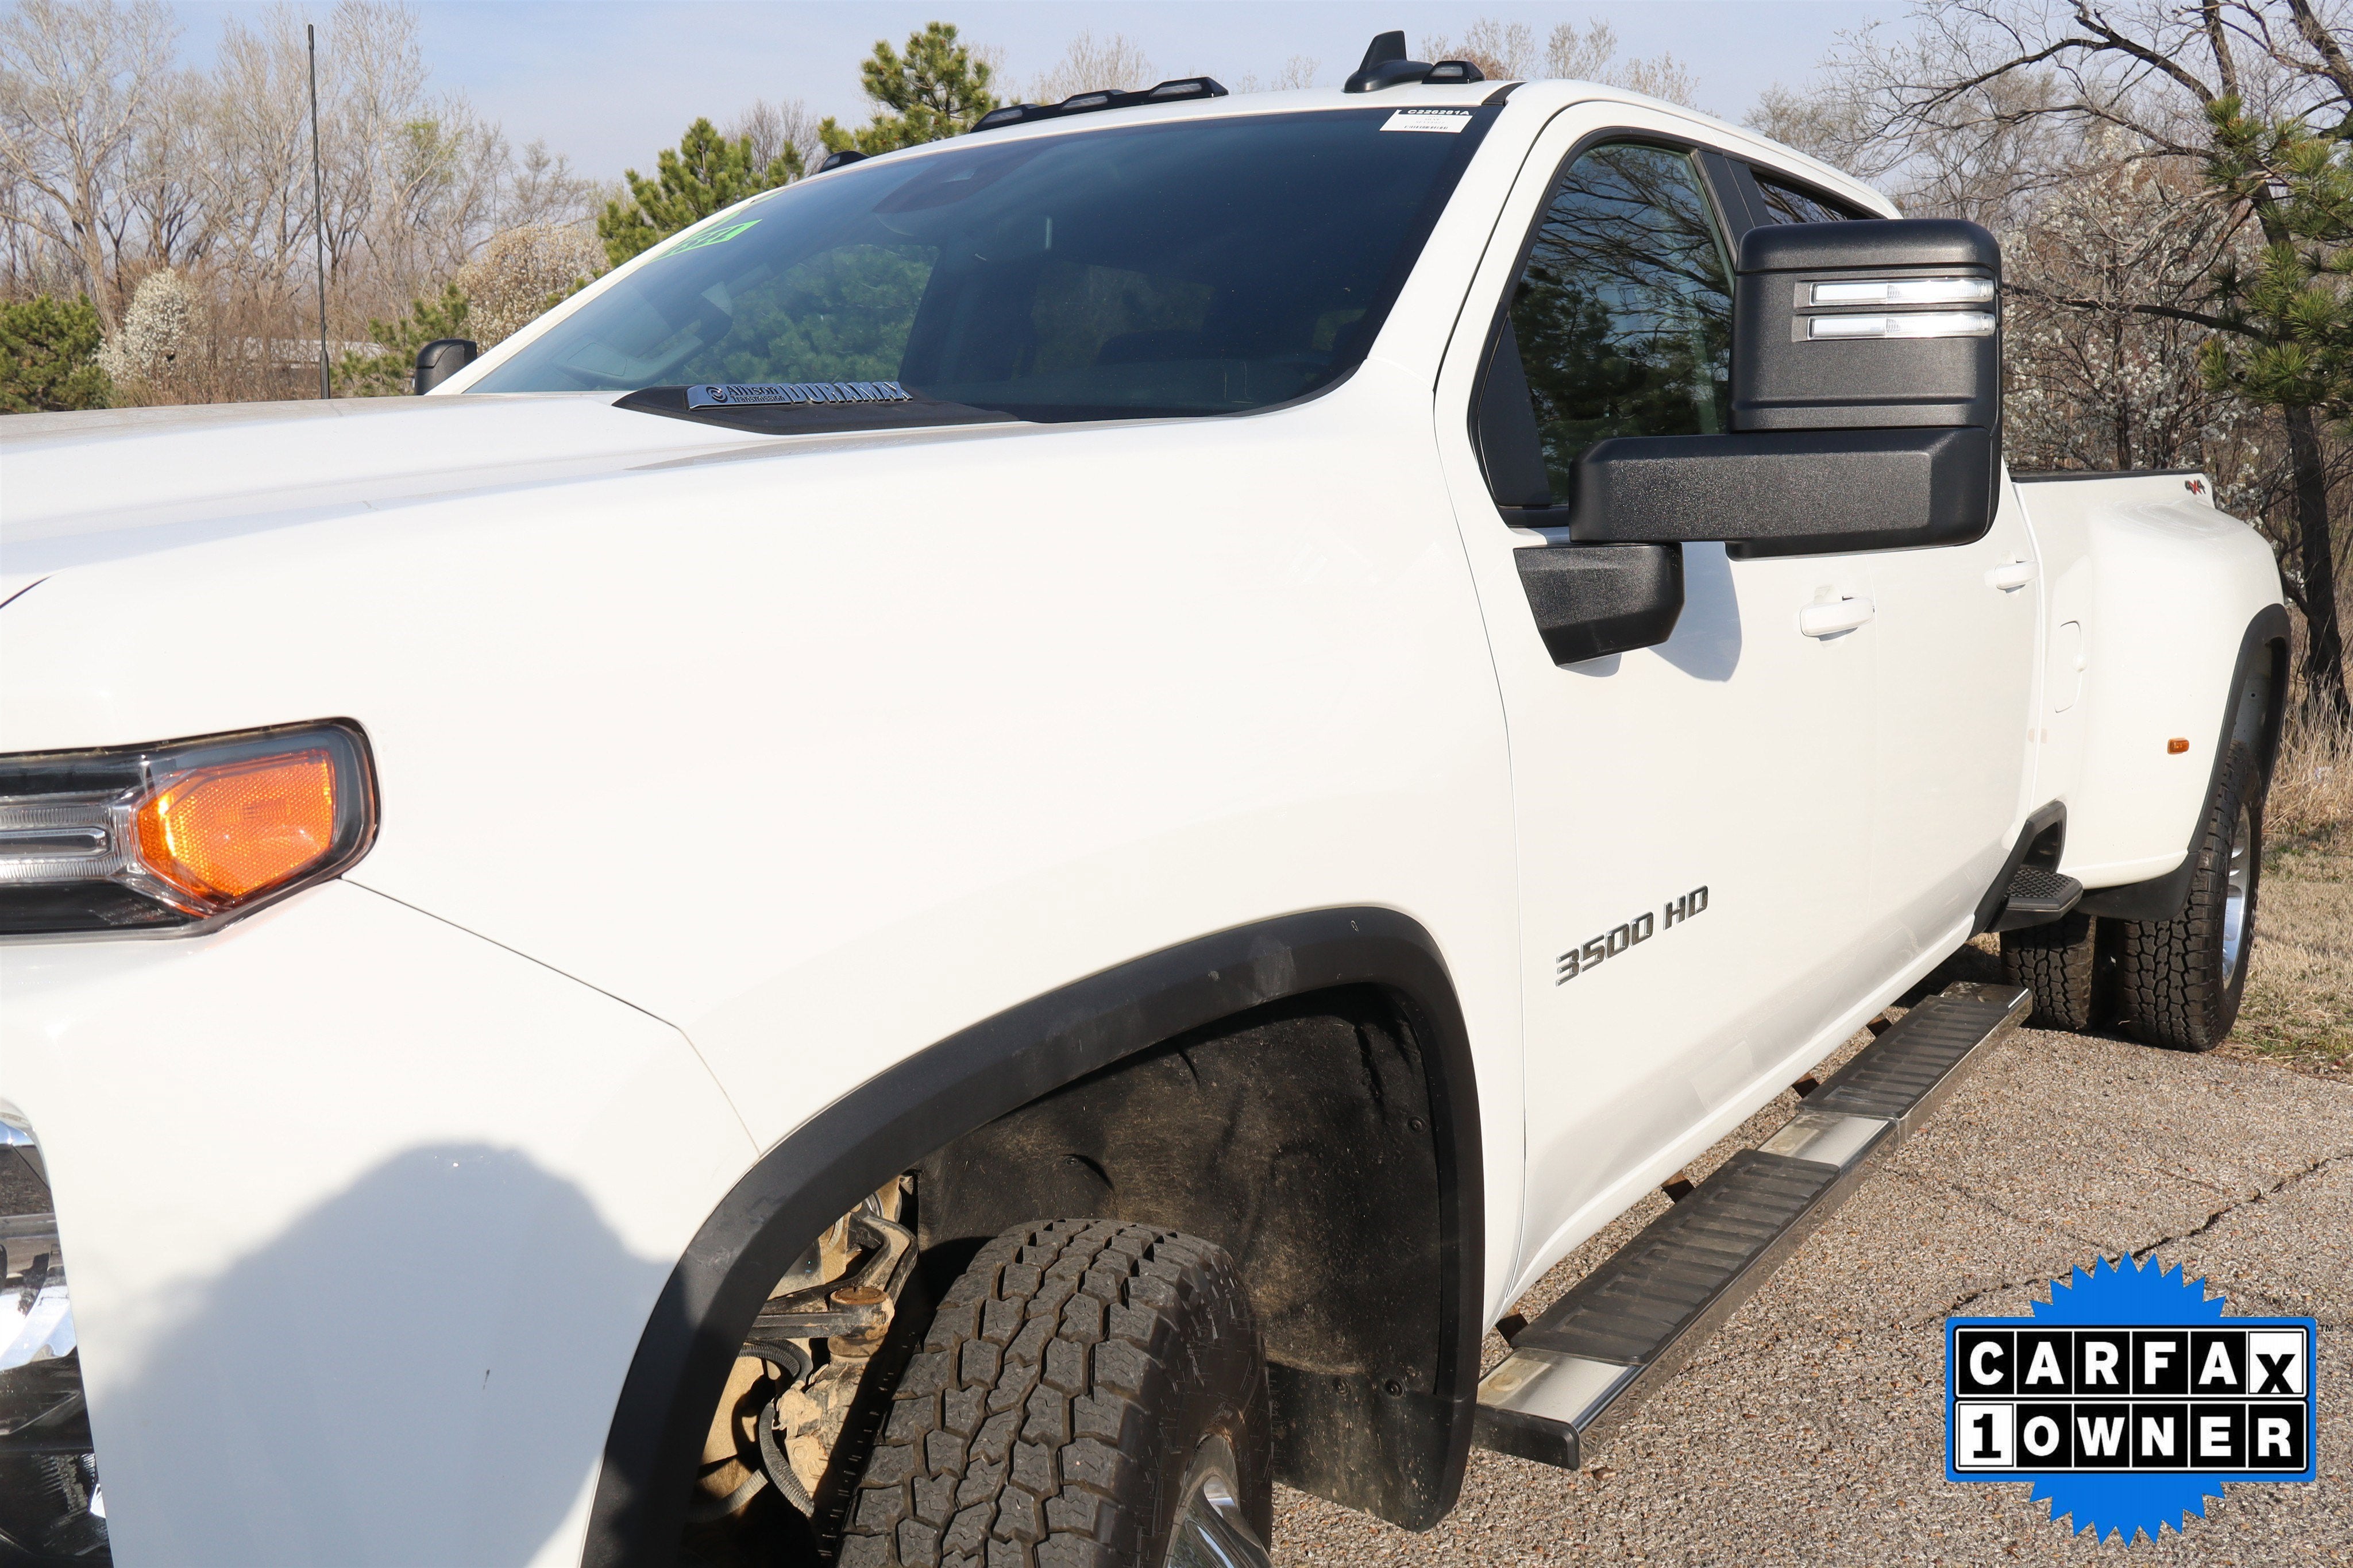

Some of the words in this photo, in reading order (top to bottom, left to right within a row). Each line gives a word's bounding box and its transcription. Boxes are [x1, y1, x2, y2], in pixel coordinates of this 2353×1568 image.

[726, 385, 781, 395] Allison
[778, 381, 914, 404] DURAMAX
[730, 394, 786, 403] Transmission
[1556, 911, 1654, 987] 3500
[1662, 885, 1708, 930] HD
